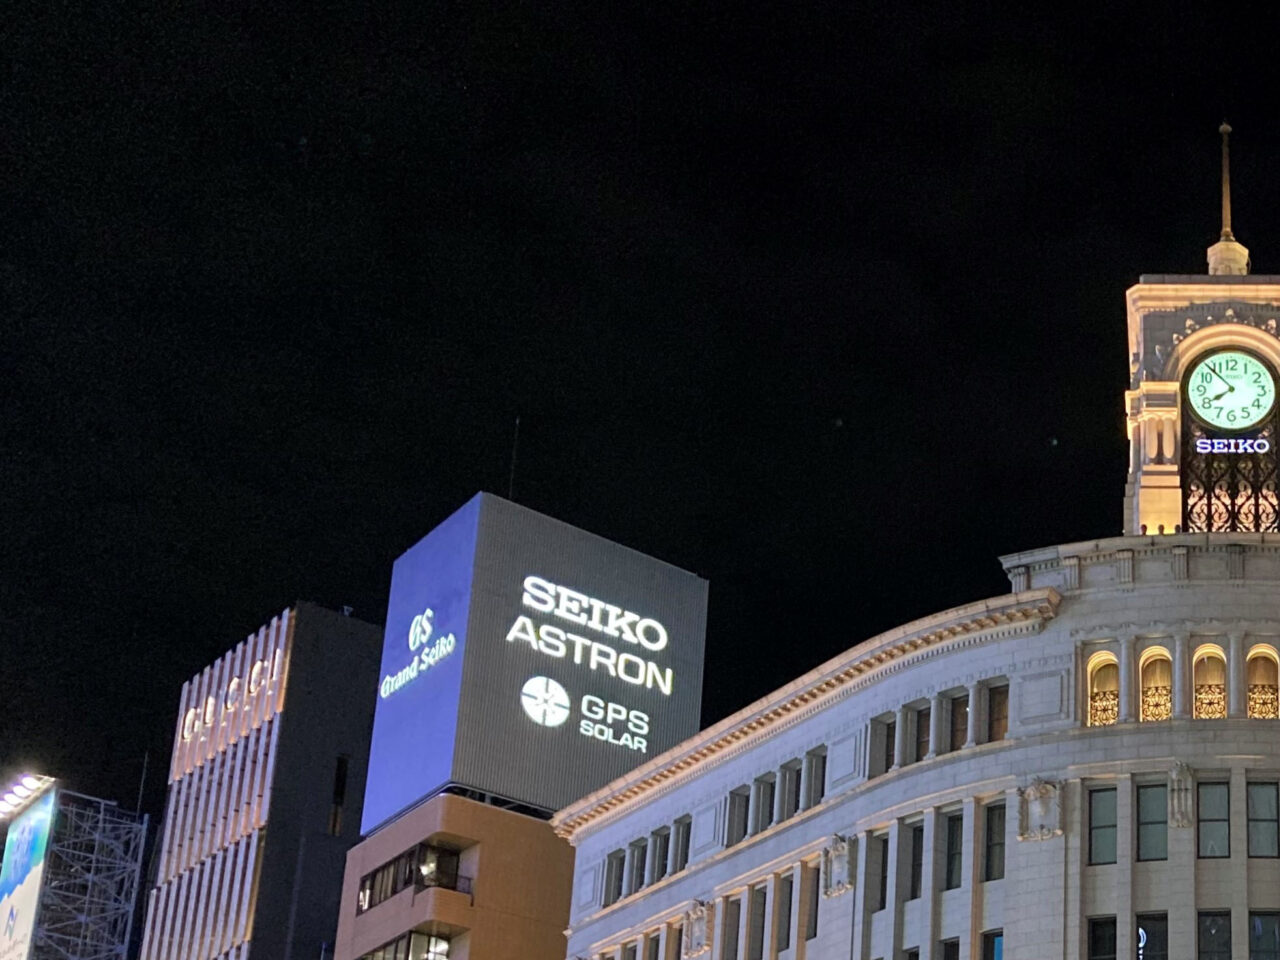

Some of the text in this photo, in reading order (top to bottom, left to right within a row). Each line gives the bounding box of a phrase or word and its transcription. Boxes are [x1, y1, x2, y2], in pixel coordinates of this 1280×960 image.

[1225, 359, 1238, 371] 12
[1244, 362, 1248, 375] 1
[1201, 371, 1213, 384] 10
[1252, 371, 1262, 383] 2
[1196, 384, 1207, 397] 9
[1257, 384, 1267, 397] 3
[1201, 397, 1212, 410] 8
[1251, 398, 1263, 410] 4
[1213, 406, 1225, 419] 7
[1226, 409, 1237, 422] 6
[1241, 406, 1251, 419] 5
[1196, 438, 1270, 454] SEIKO
[522, 575, 668, 652] SEIKO
[408, 608, 434, 651] GS
[505, 615, 674, 696] ASTRON
[379, 633, 456, 699] Grand Seiko
[580, 694, 650, 736] GPS
[579, 719, 648, 753] SOLAR
